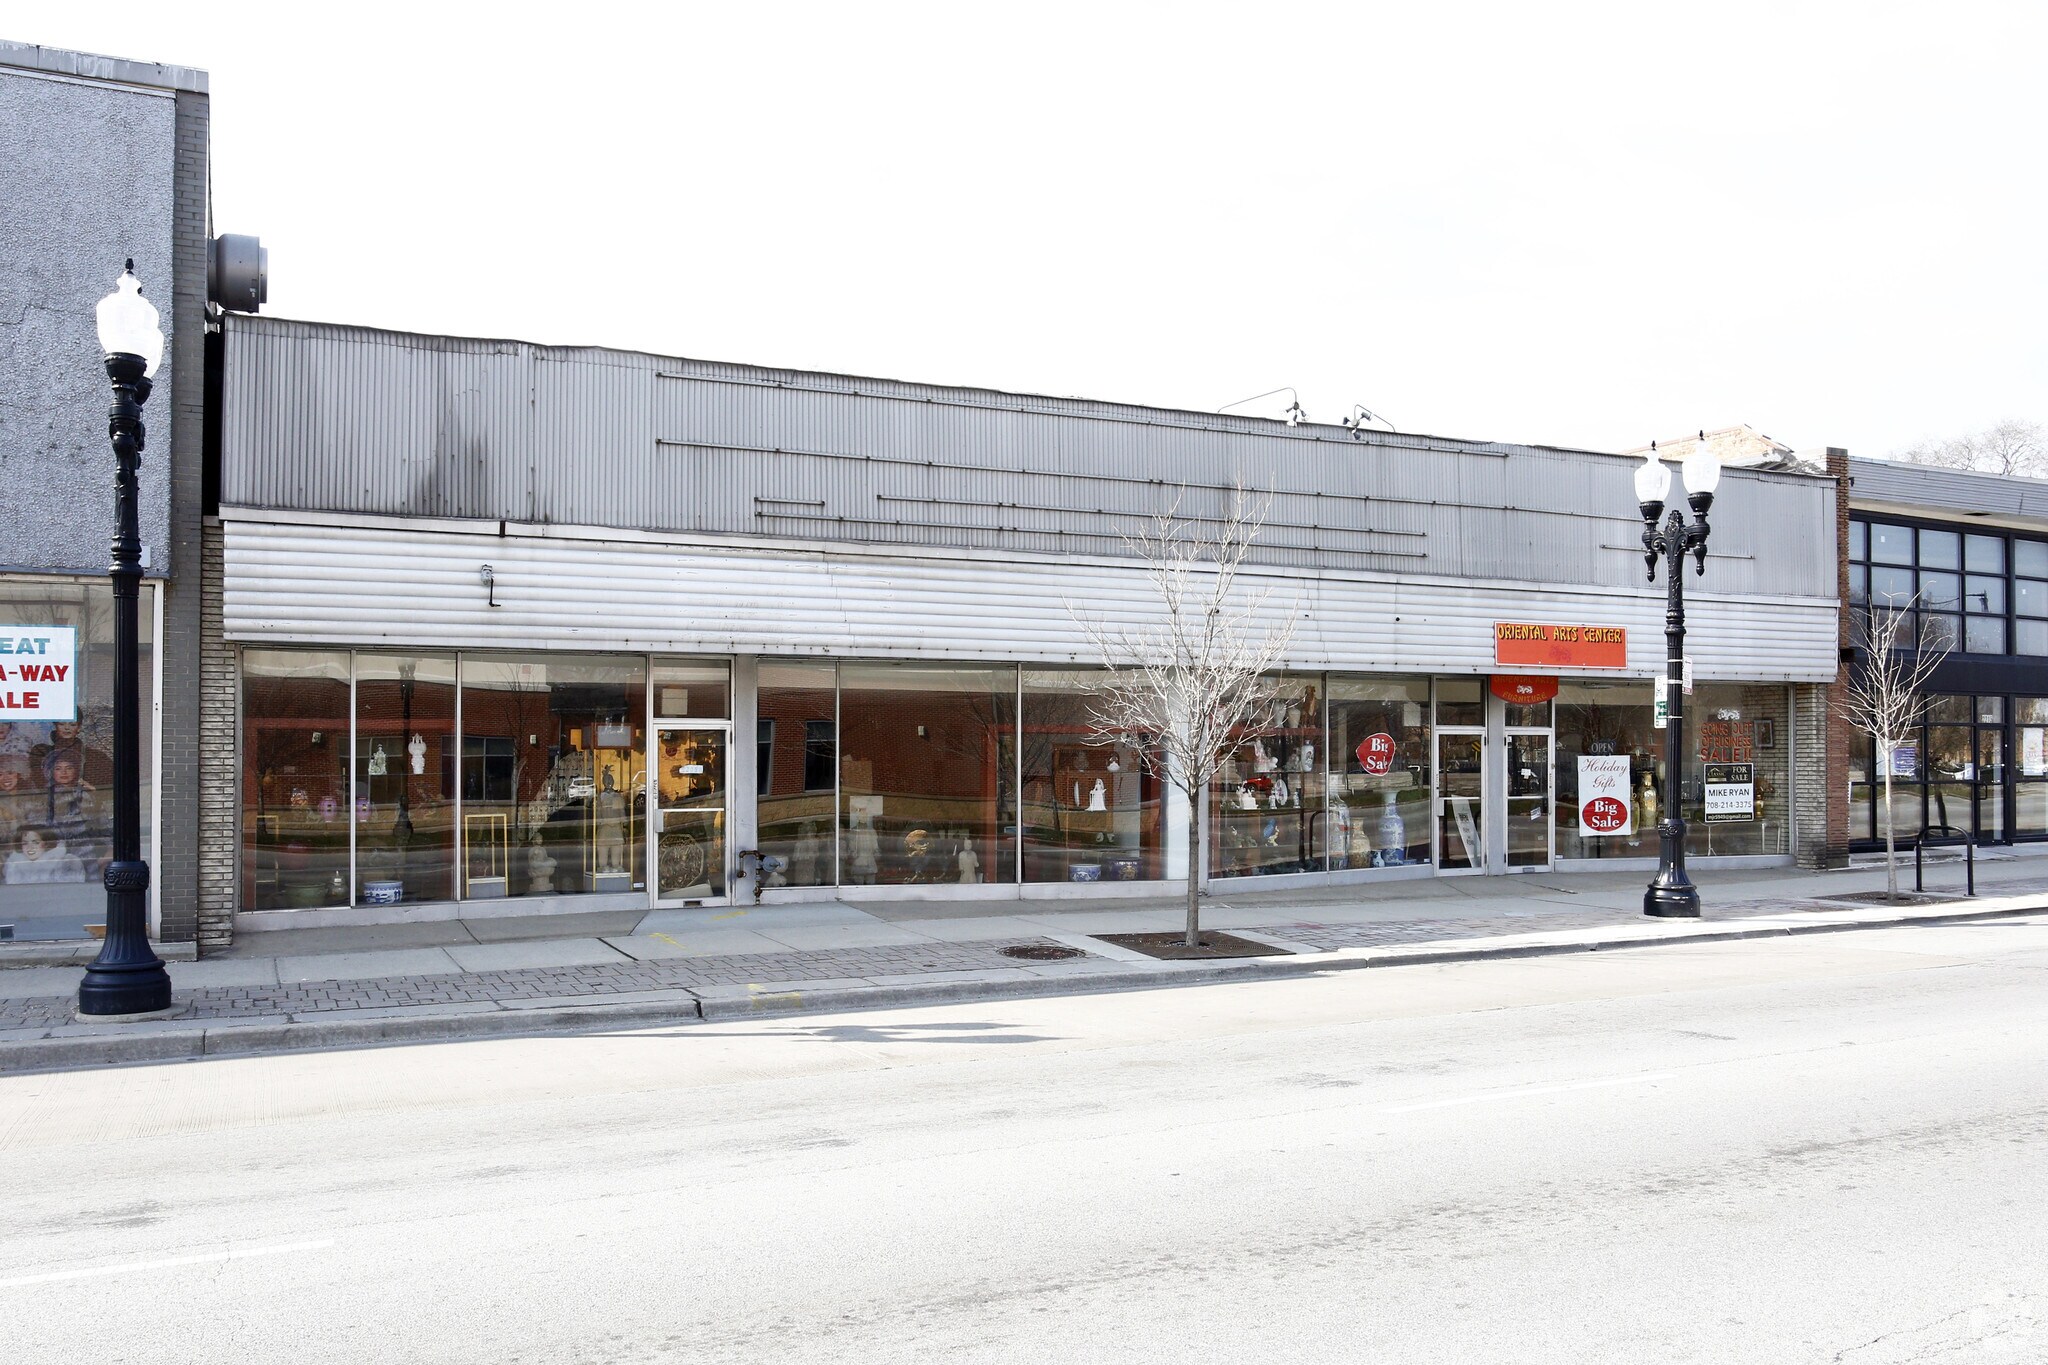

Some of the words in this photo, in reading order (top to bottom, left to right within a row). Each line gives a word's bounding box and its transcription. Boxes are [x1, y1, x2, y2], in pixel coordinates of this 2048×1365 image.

[1498, 625, 1548, 640] ORIENTAL
[1553, 626, 1578, 642] ARTS
[1583, 628, 1622, 643] CENTER
[0, 638, 50, 654] EAT
[1494, 676, 1533, 684] ORIENTAL
[1535, 676, 1555, 684] ARTS
[0, 692, 39, 708] LE
[1502, 691, 1547, 702] FURNITURE
[1700, 722, 1729, 735] GOING
[1732, 722, 1752, 735] OUT
[1591, 742, 1614, 753] OPEN
[1702, 735, 1713, 747] OF
[1714, 735, 1752, 748] BUSINESS
[1581, 758, 1628, 777] Holiday
[1592, 774, 1616, 792] Gifts
[1708, 789, 1728, 797] MIKE
[1729, 788, 1750, 796] RYAN
[1594, 800, 1618, 815] Big
[1706, 801, 1752, 809] 708-214-3375
[1591, 815, 1620, 828] Sale
